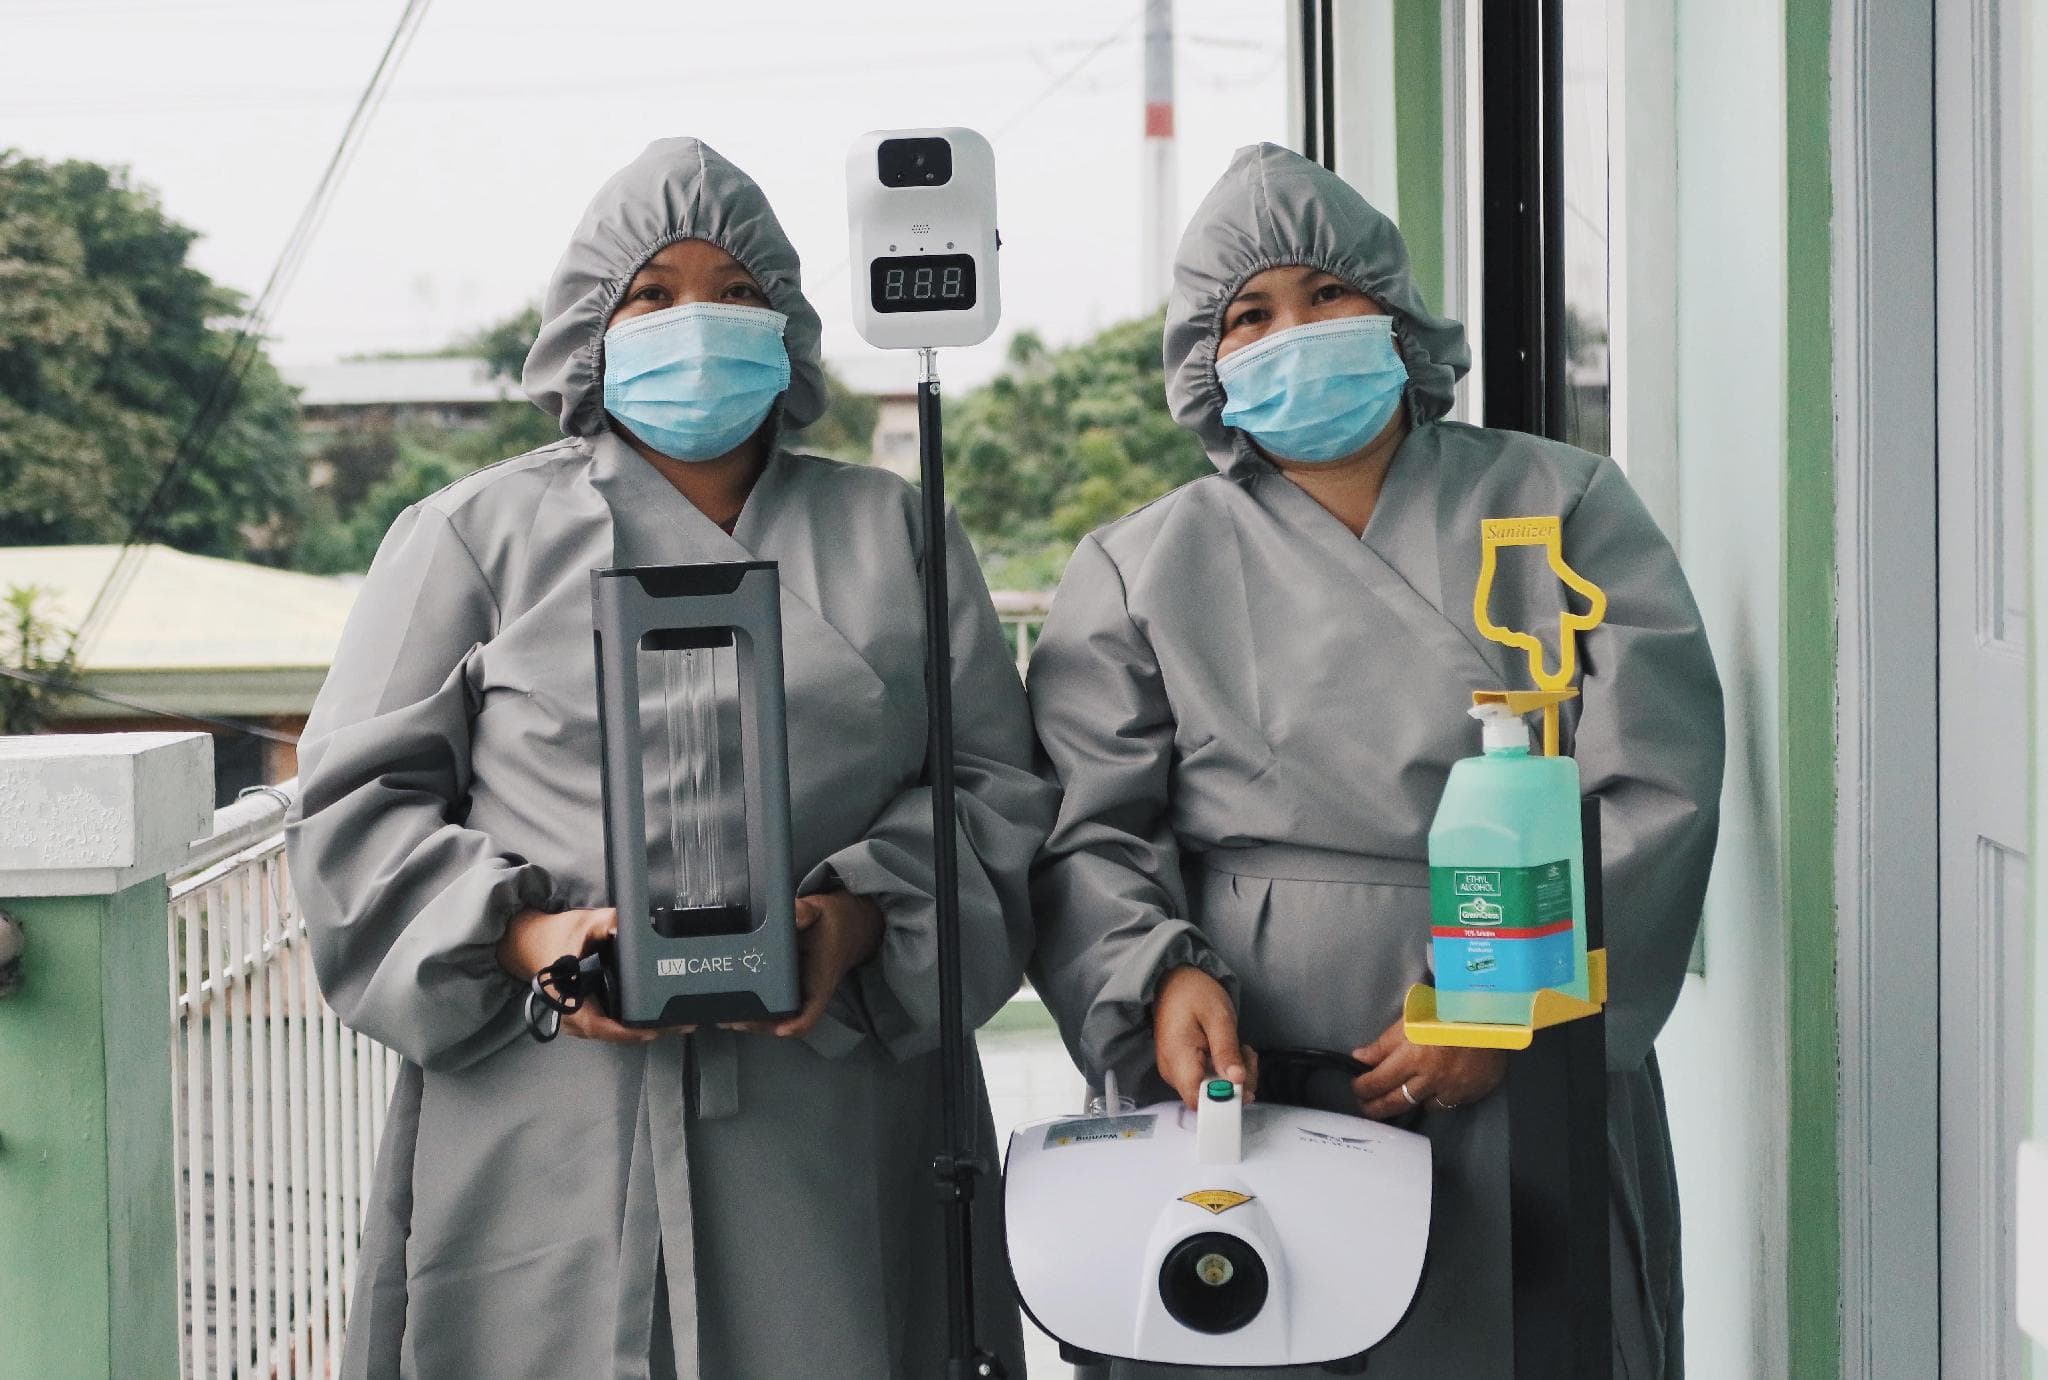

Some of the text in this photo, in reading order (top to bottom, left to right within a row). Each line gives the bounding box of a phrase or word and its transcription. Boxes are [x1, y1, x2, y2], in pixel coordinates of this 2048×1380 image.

[1487, 523, 1556, 540] Sanitizer
[1466, 875, 1489, 884] ETHYL
[1461, 883, 1496, 892] ALCOHOL
[659, 957, 734, 975] UV CARE
[1076, 1134, 1119, 1142] Warning
